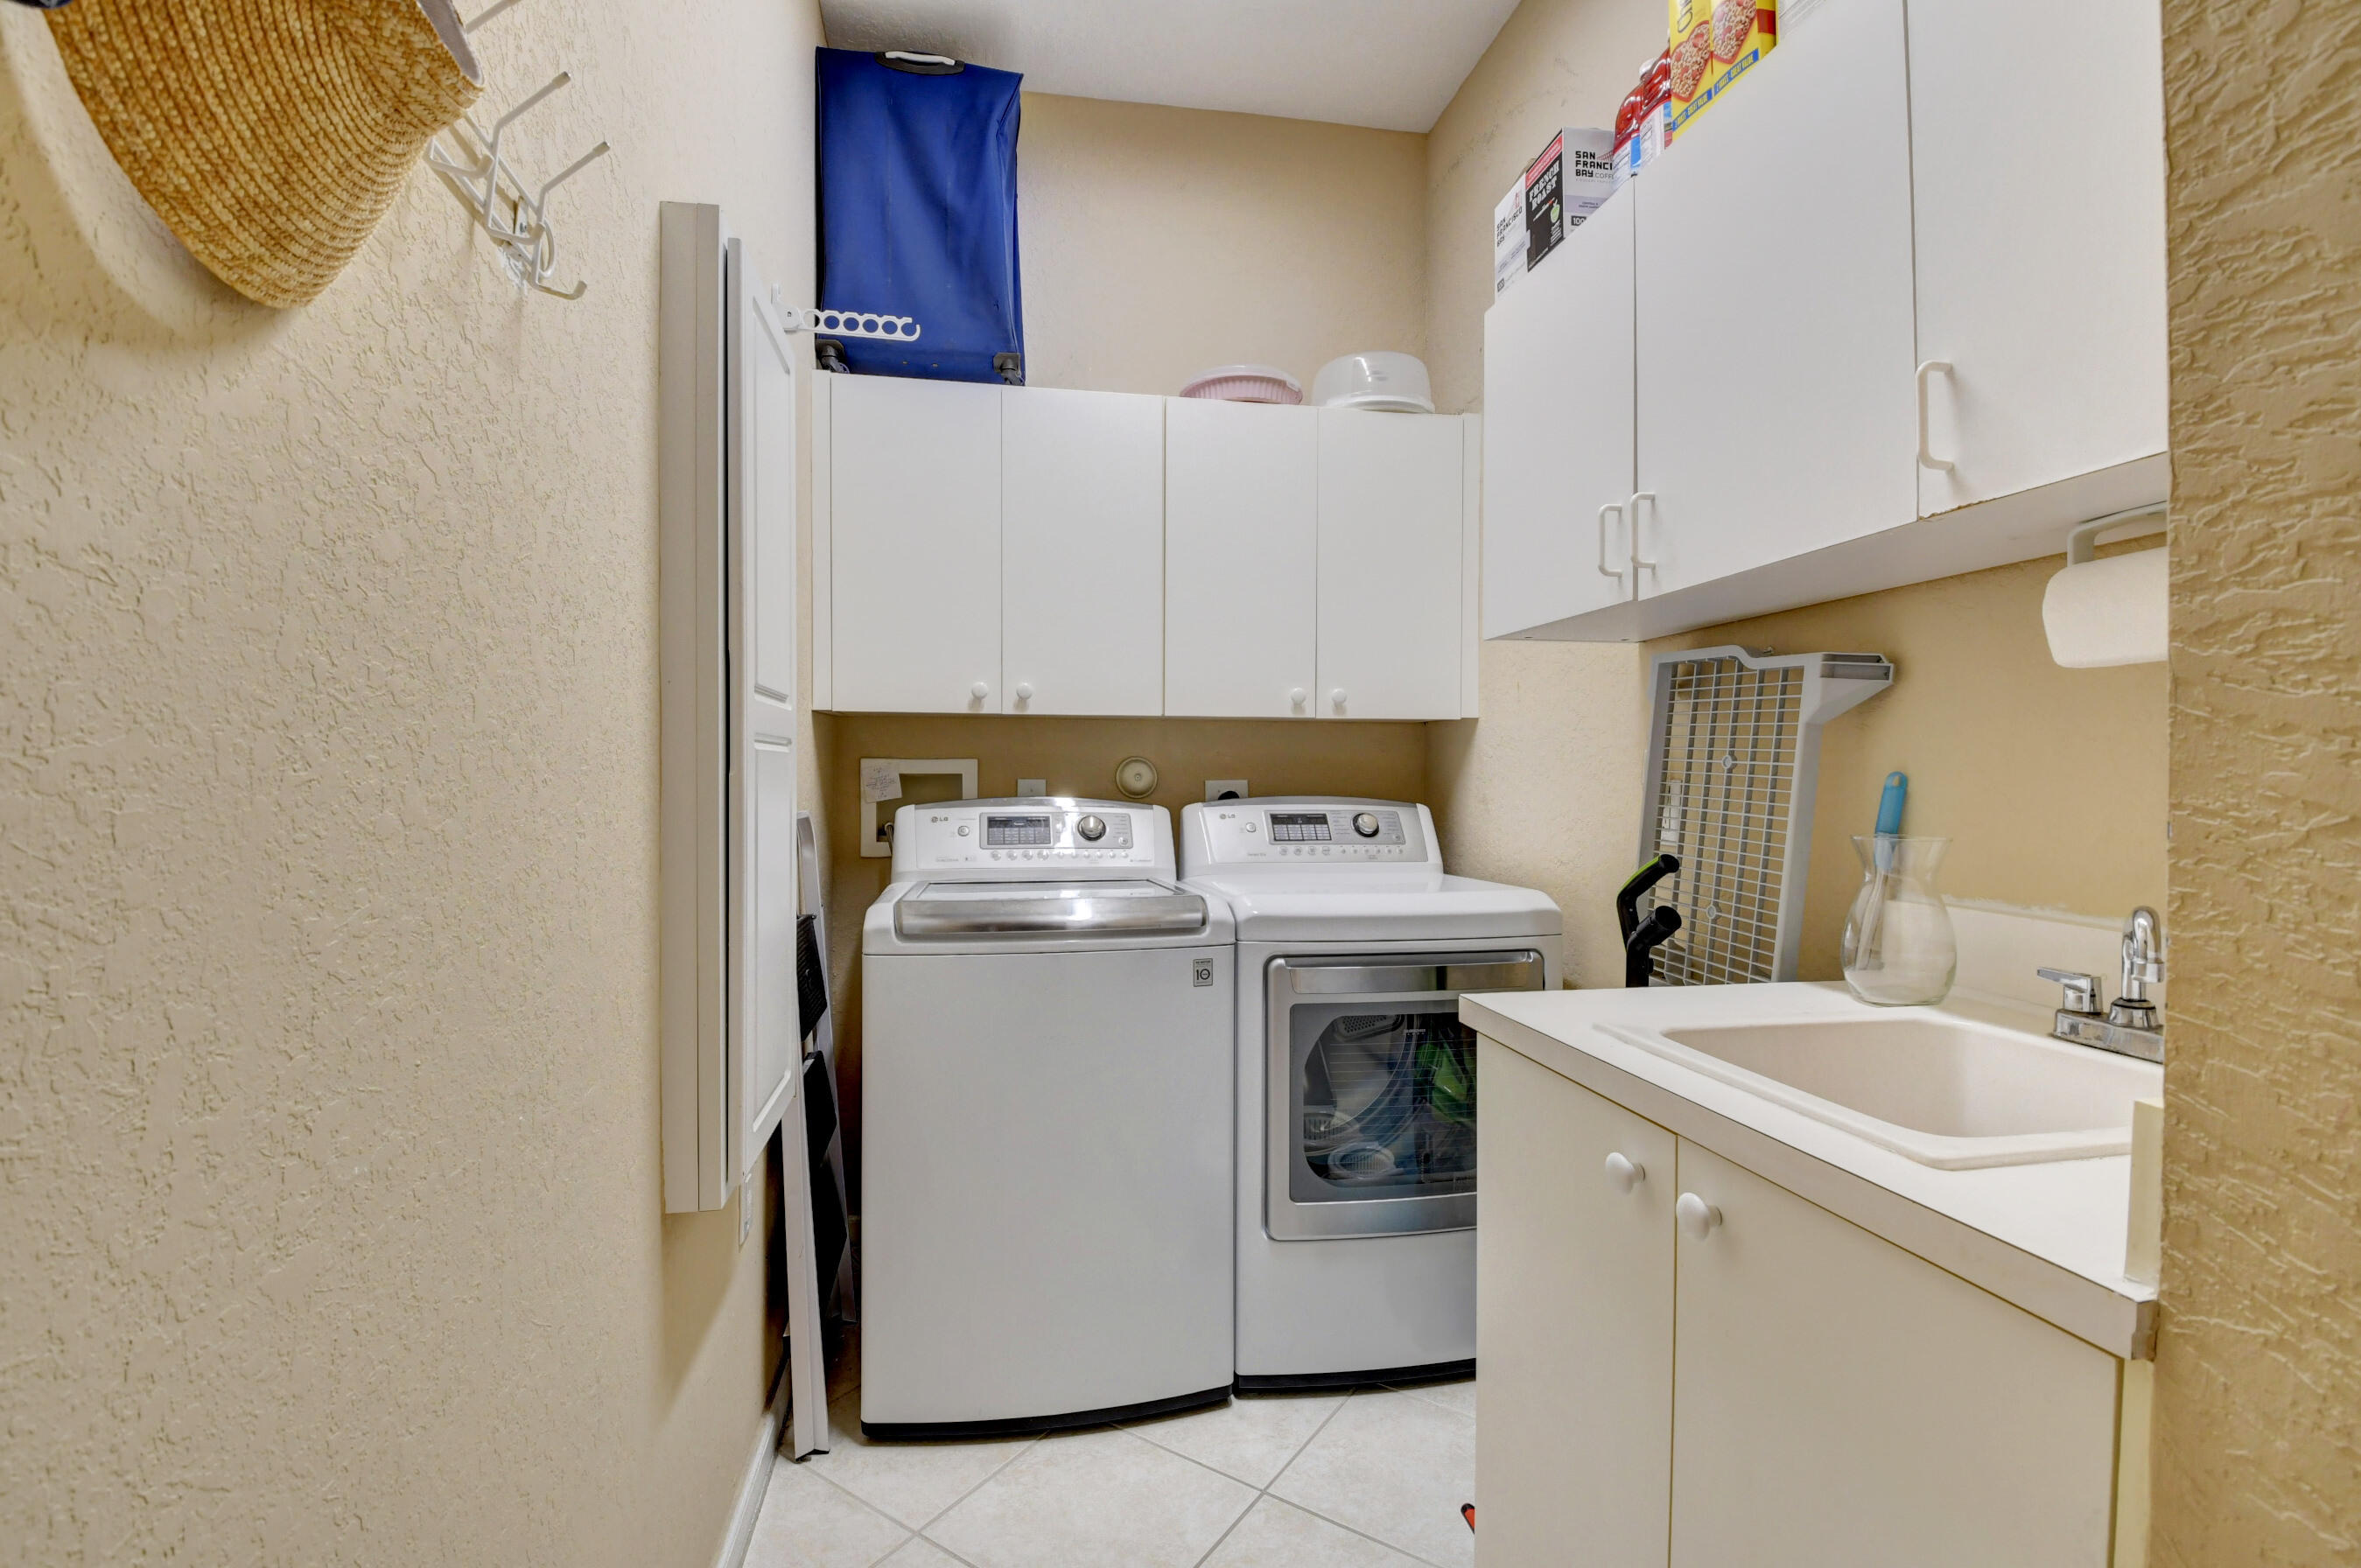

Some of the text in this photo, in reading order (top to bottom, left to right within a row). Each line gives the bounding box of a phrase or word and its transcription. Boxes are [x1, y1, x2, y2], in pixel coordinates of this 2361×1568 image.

[1575, 150, 1595, 160] SAN
[1575, 160, 1613, 171] FRANCI
[1575, 169, 1594, 178] BAY
[1529, 160, 1559, 203] FRENCH
[1531, 175, 1558, 211] ROAST
[1496, 206, 1523, 240] FRANCISCO
[1496, 216, 1506, 232] SAN
[1195, 969, 1210, 980] 10
